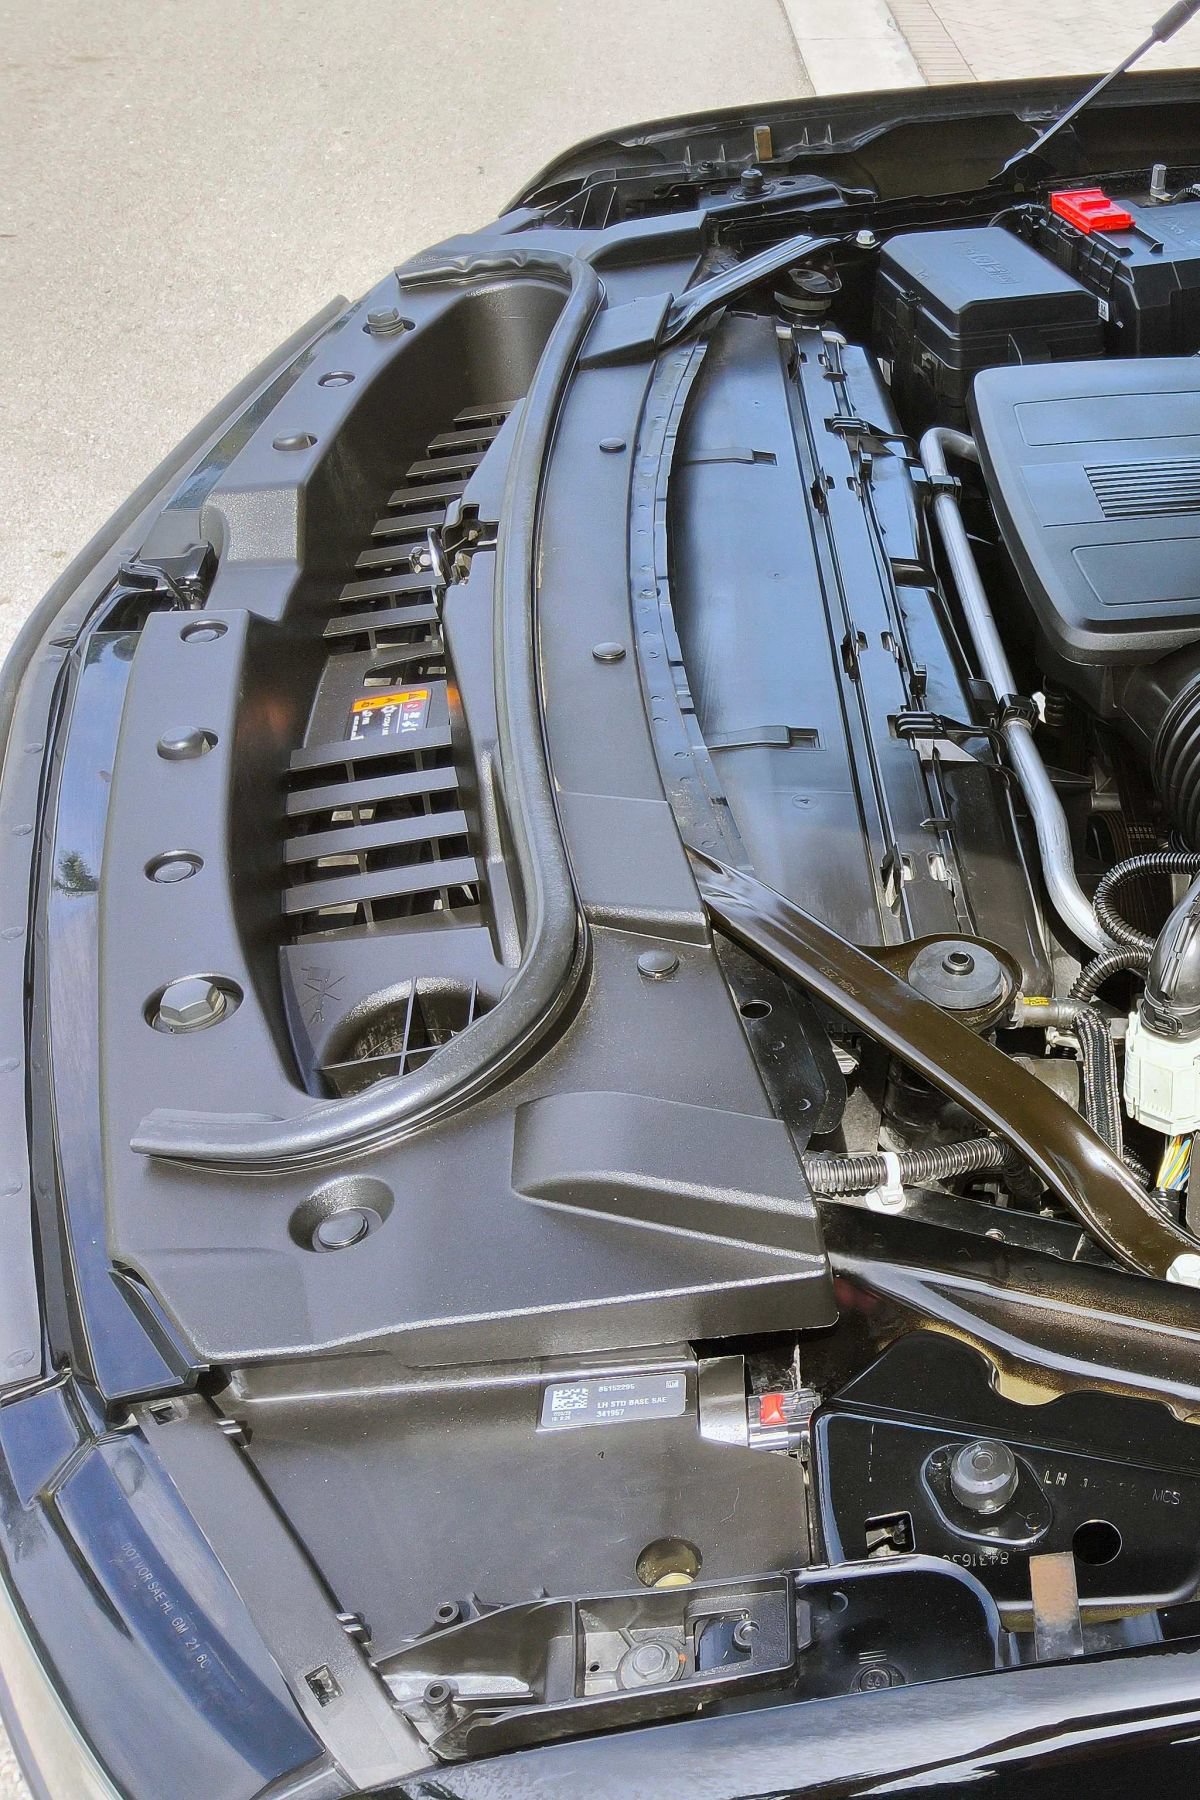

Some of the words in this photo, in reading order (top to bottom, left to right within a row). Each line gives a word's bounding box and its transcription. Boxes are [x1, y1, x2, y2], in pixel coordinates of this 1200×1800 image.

[597, 1401, 609, 1409] LH
[610, 1399, 627, 1408] STD
[628, 1397, 650, 1406] BASE
[651, 1396, 668, 1404] SAE
[1043, 1470, 1068, 1487] LH
[121, 1542, 141, 1561] DOT
[147, 1581, 167, 1602] SAE
[160, 1601, 174, 1616] HL
[171, 1617, 190, 1635] GM
